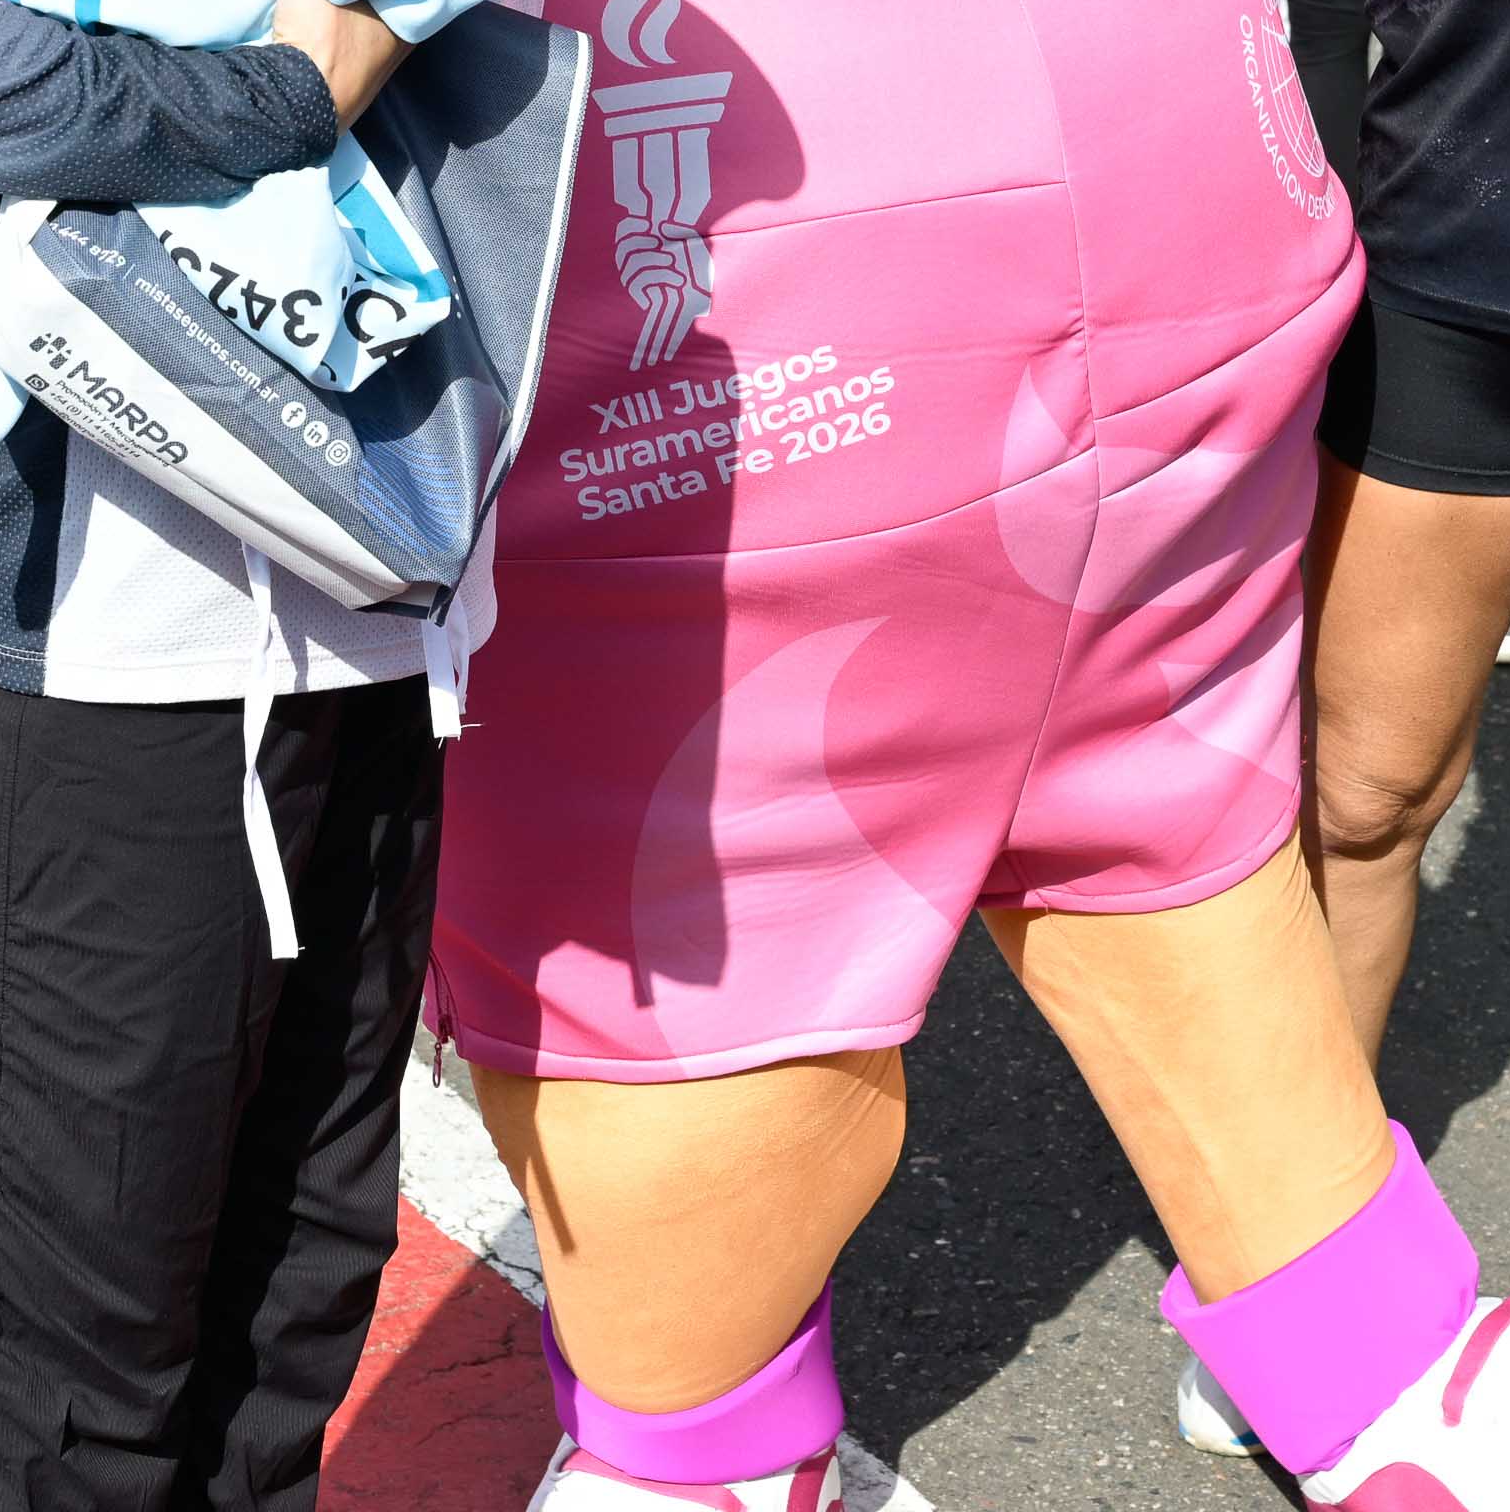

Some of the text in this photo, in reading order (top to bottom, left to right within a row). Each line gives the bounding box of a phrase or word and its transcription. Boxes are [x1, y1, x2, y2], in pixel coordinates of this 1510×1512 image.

[1239, 13, 1308, 215] ORGANIZACION
[134, 276, 280, 403] mistaseguros.com.ar
[590, 345, 838, 434] XIII Juegos
[66, 359, 189, 465] MARPA
[559, 366, 895, 482] Suramericanos
[577, 402, 892, 521] Santa Fe 2026
